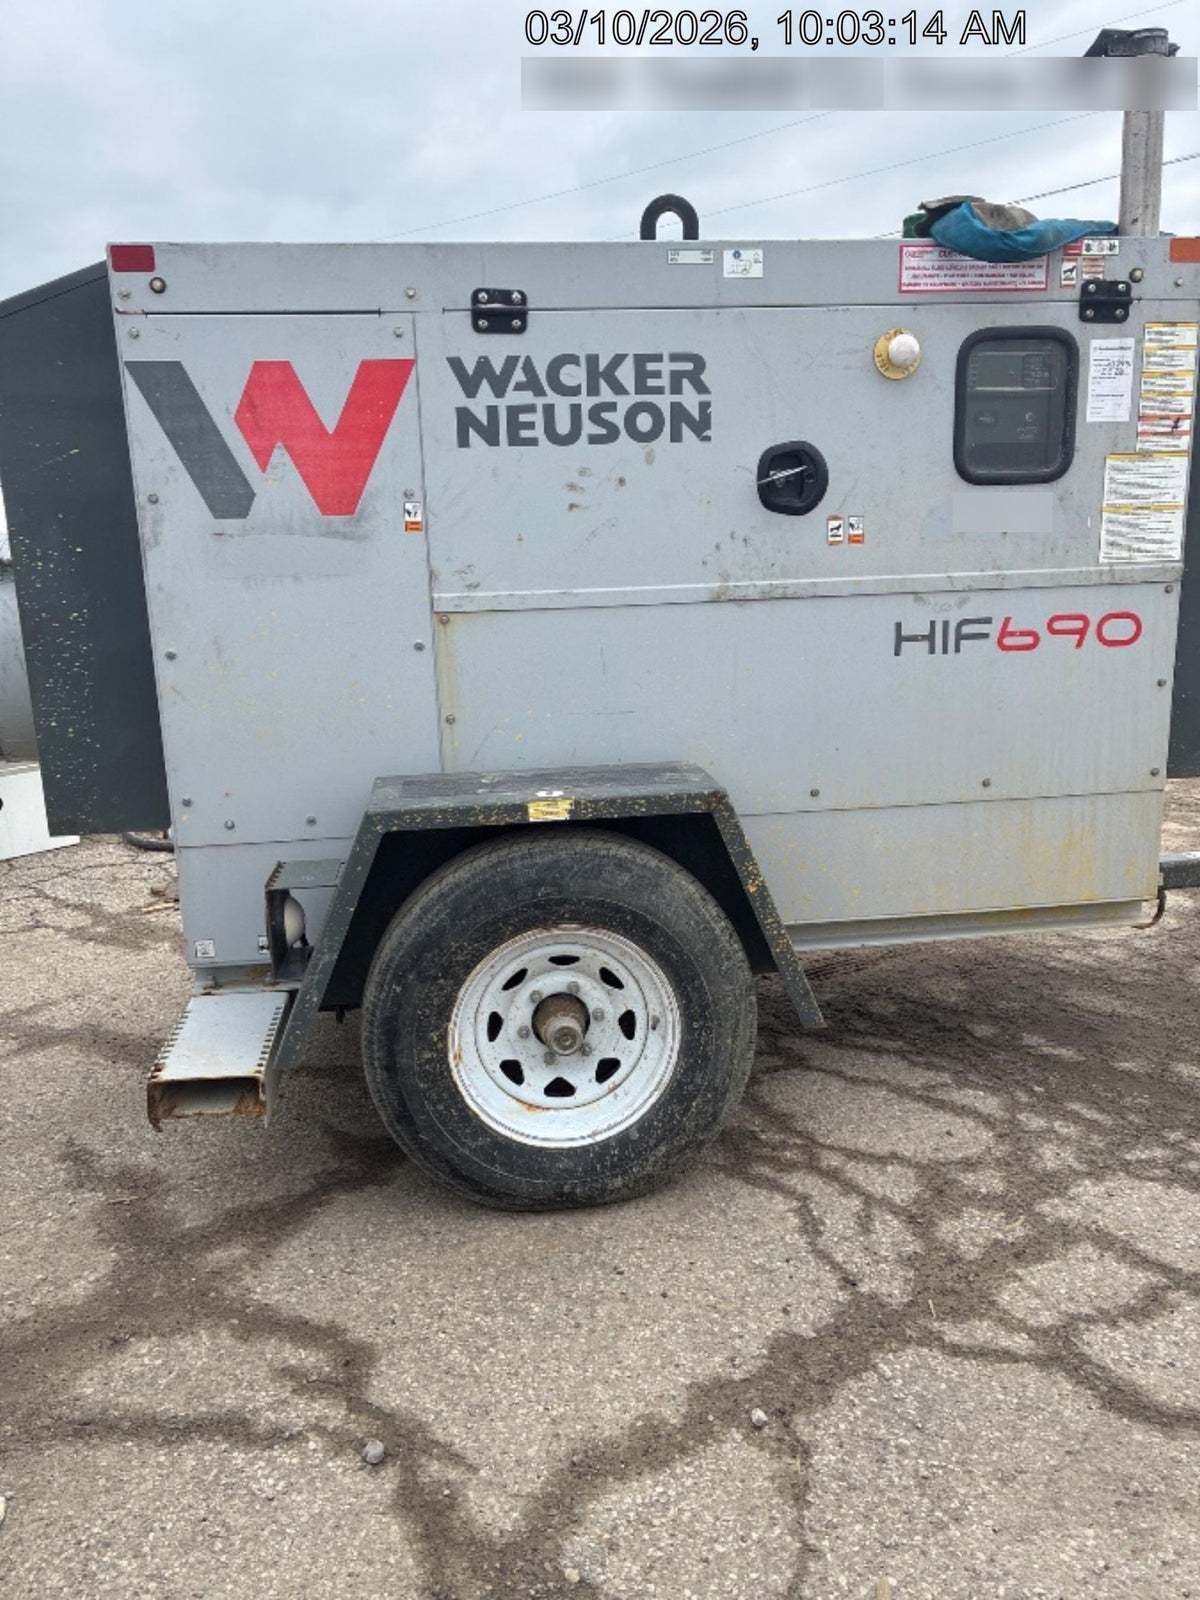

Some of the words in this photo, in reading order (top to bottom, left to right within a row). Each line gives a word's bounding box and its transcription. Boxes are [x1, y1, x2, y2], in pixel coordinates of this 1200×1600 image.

[446, 352, 712, 399] WACKER
[455, 401, 712, 448] NEUSON
[894, 611, 1143, 657] HIF690
